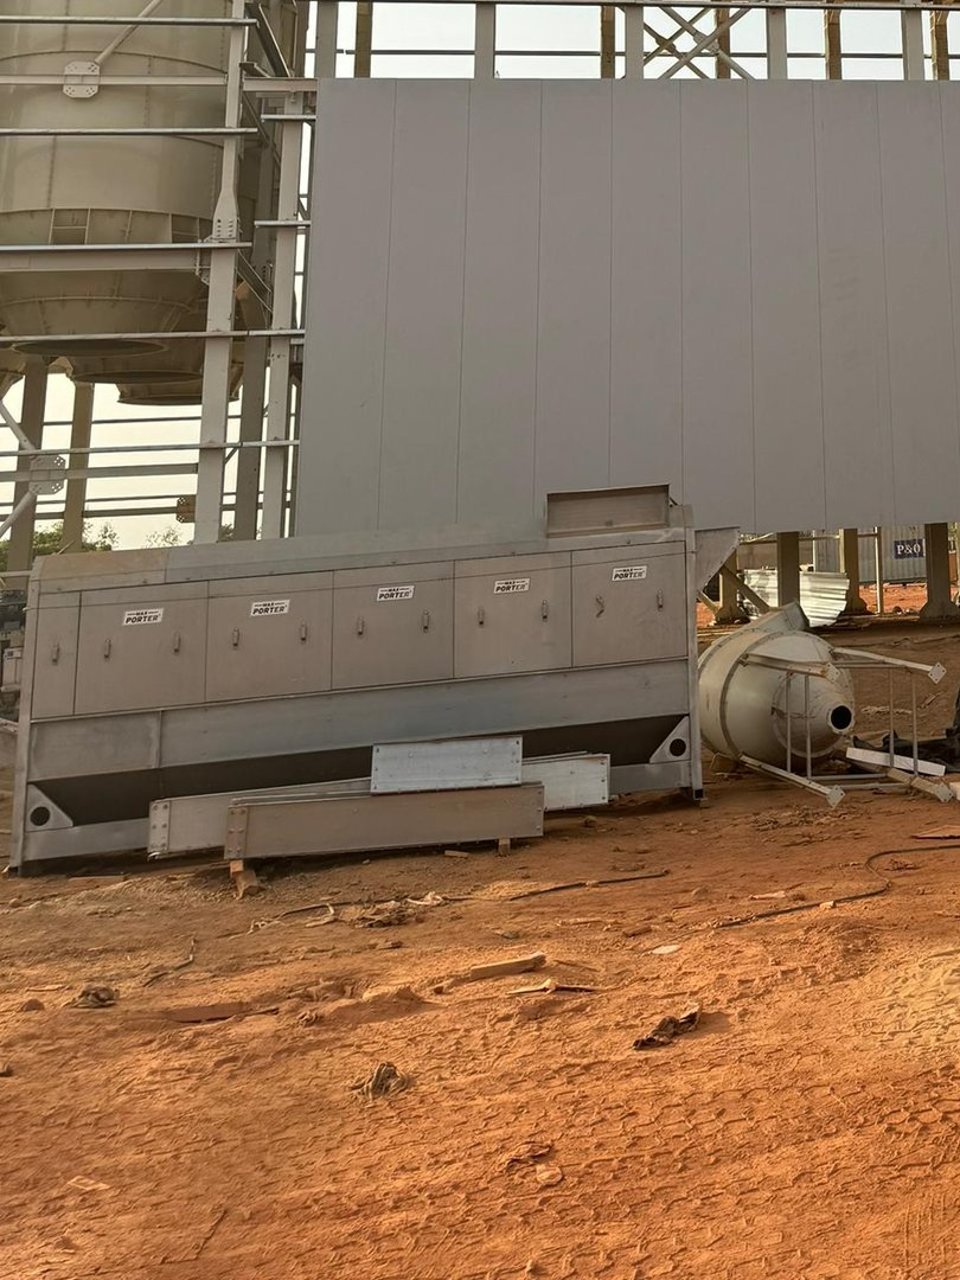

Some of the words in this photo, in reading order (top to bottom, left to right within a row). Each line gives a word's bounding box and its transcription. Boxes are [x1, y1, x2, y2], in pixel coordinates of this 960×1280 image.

[896, 543, 921, 555] P&O
[613, 570, 644, 580] PORTER
[495, 583, 526, 592] PORTER
[378, 590, 410, 600] PORTER
[252, 605, 285, 615] PORTER
[125, 614, 159, 624] PORTER
